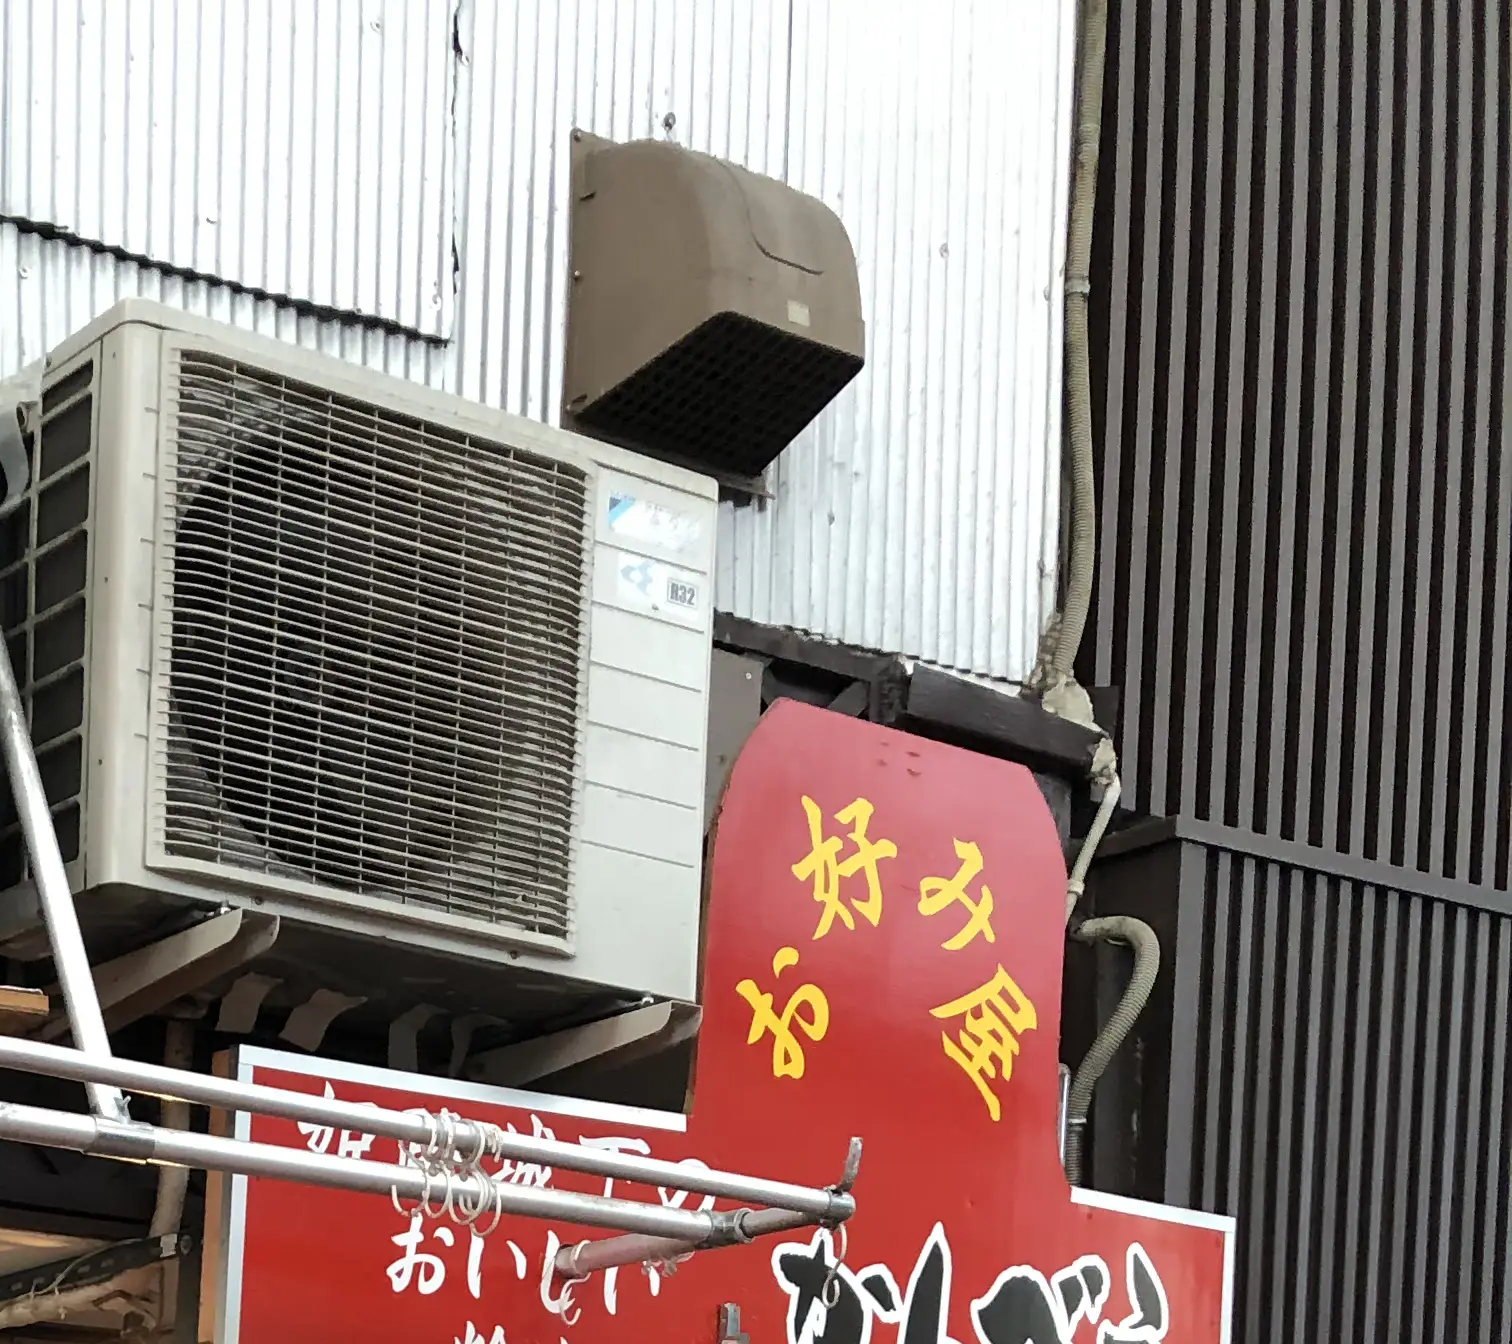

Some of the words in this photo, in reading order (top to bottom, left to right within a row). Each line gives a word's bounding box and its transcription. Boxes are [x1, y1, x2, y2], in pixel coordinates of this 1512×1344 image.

[670, 583, 695, 606] R32
[736, 795, 1038, 1122] お好み屋
